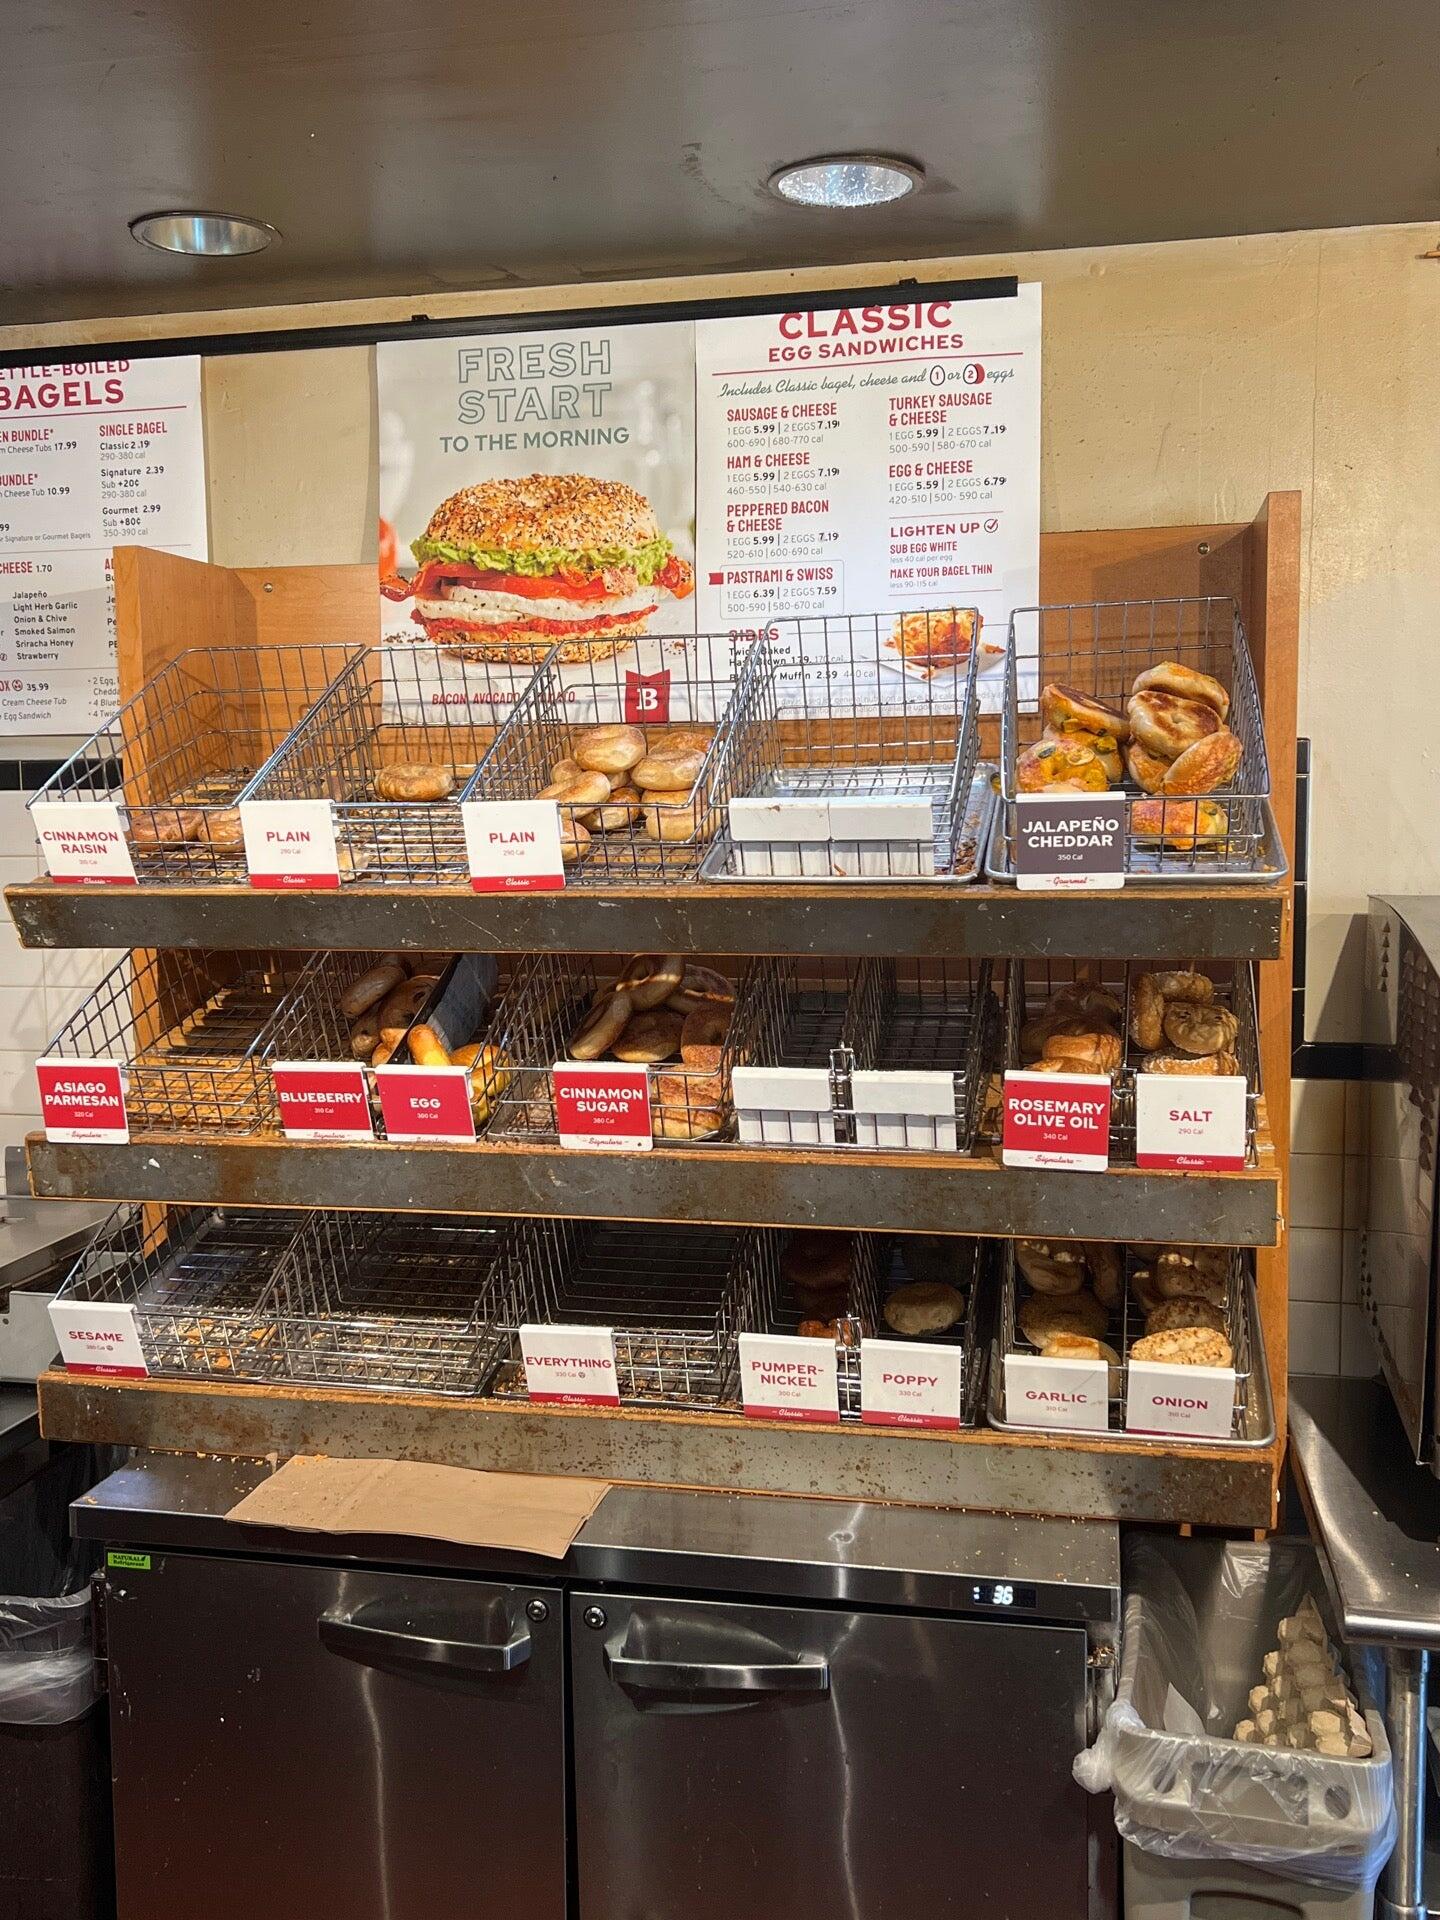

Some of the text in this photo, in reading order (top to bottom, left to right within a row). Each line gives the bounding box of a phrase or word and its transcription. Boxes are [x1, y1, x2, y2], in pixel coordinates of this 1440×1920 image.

[779, 301, 952, 339] CLASSIC
[769, 334, 964, 363] EGG SANDWICHES
[458, 340, 611, 383] FRESH
[717, 382, 772, 397] Includes
[775, 376, 818, 393] Classic
[821, 373, 856, 392] bagel,
[859, 372, 899, 387] cheese
[901, 369, 927, 384] and
[947, 371, 960, 381] or
[967, 370, 974, 379] 2
[986, 368, 1015, 383] eggs
[458, 382, 612, 424] START
[889, 392, 992, 410] TURKEY SAUSAGE
[727, 402, 837, 422] SAUSAGE & CHEESE
[889, 410, 947, 426] & CHEESE
[99, 421, 167, 438] SINGLE BAGEL
[733, 427, 751, 436] EGG
[753, 424, 775, 434] 5.99
[792, 422, 816, 432] EGGS
[895, 431, 914, 440] EGG
[916, 428, 939, 438] 5.99
[956, 426, 981, 436] EGGS
[440, 428, 629, 452] TO THE MORNING
[8, 445, 33, 453] Cheese
[36, 444, 52, 452] Tubs
[54, 441, 77, 451] 17.99
[100, 442, 130, 451] Classic
[727, 452, 810, 469] HAM & CHEESE
[101, 466, 164, 478] Signature 2.39
[753, 472, 775, 481] 5.99
[792, 469, 816, 479] EGGS
[889, 460, 973, 478] EGG & CHEESE
[47, 487, 70, 495] 10.99
[101, 481, 116, 489] Sub
[916, 480, 939, 490] 5.59
[102, 504, 161, 515] Gourmet 2.99
[727, 500, 829, 517] PEPPERED BACON
[103, 518, 117, 527] Sub
[726, 518, 782, 532] & CHEESE
[890, 522, 980, 538] LIGHTEN UP
[753, 535, 774, 545] 5.99
[890, 541, 957, 554] SUB EGG WHITE
[36, 564, 53, 572] 1.70
[890, 564, 992, 579] MAKE YOUR BAGEL THIN
[727, 567, 833, 584] PASTRAMI & SWISS
[12, 591, 47, 600] Jalapeño
[753, 586, 837, 598] 6.39 7.59
[13, 602, 78, 612] Light Herb Garlic
[14, 615, 36, 623] Onion
[47, 627, 76, 635] Salmon
[16, 639, 74, 648] Sriracha Honey
[27, 683, 49, 691] 35.99
[636, 688, 658, 711] B
[4, 713, 17, 721] Egg
[1022, 816, 1119, 833] JALAPEÑO
[43, 831, 119, 841] CINNAMON
[266, 831, 311, 842] PLAIN
[489, 832, 535, 843] PLAIN
[1028, 834, 1113, 848] CHEDDAR
[61, 844, 108, 854] RAISIN
[282, 875, 306, 884] Classic
[505, 878, 530, 886] Classic
[54, 1082, 106, 1093] ASIAGO
[280, 1092, 363, 1104] BLUEBERRY
[560, 1088, 643, 1100] CINNAMON
[45, 1095, 119, 1107] PARMESAN
[410, 1098, 441, 1109] EGG
[577, 1101, 629, 1113] SUGAR
[1008, 1098, 1106, 1115] ROSEMARY
[1013, 1113, 1099, 1130] OLIVE OIL
[1169, 1110, 1213, 1122] SALT
[1057, 1133, 1068, 1141] Cal
[1176, 1156, 1205, 1165] Classic
[69, 1330, 124, 1342] SESAME
[526, 1357, 612, 1368] EVERYTHING
[752, 1361, 824, 1375] PUMPER-
[760, 1374, 818, 1388] NICKEL
[882, 1373, 939, 1387] POPPY
[1025, 1390, 1088, 1404] GARLIC
[1152, 1396, 1209, 1409] ONION
[778, 1409, 804, 1418] Classic
[897, 1415, 924, 1424] Classic
[993, 1585, 1013, 1605] 36
